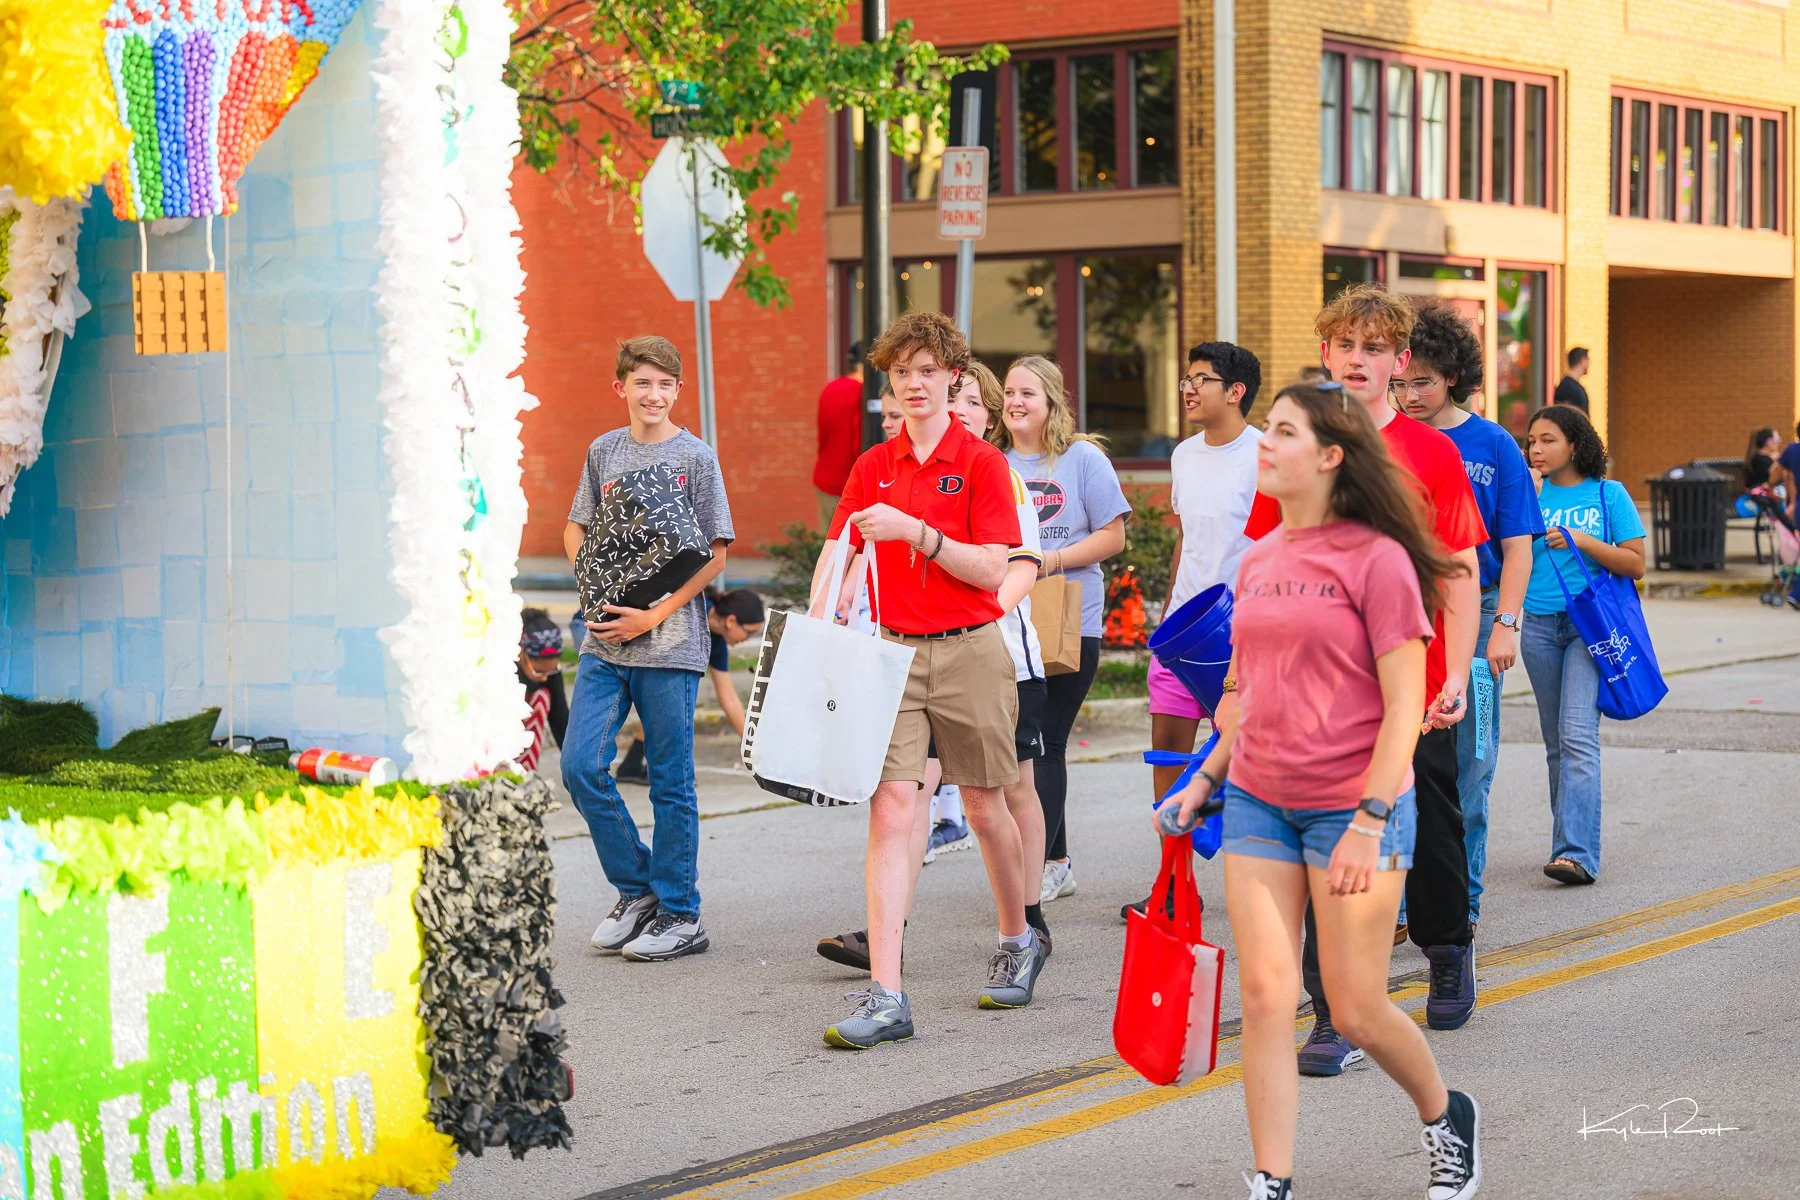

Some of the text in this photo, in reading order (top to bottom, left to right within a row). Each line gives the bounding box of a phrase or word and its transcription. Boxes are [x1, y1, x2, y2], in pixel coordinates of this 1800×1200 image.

[954, 160, 973, 178] NO
[942, 185, 982, 202] REVERSE
[942, 209, 982, 226] PARKING
[1462, 460, 1496, 487] MS
[936, 475, 965, 495] D
[1032, 494, 1064, 506] IDERS
[1541, 505, 1601, 528] CATUR
[1039, 526, 1070, 539] OSTERS
[1244, 580, 1335, 598] CATUR
[99, 1070, 377, 1199] Edition
